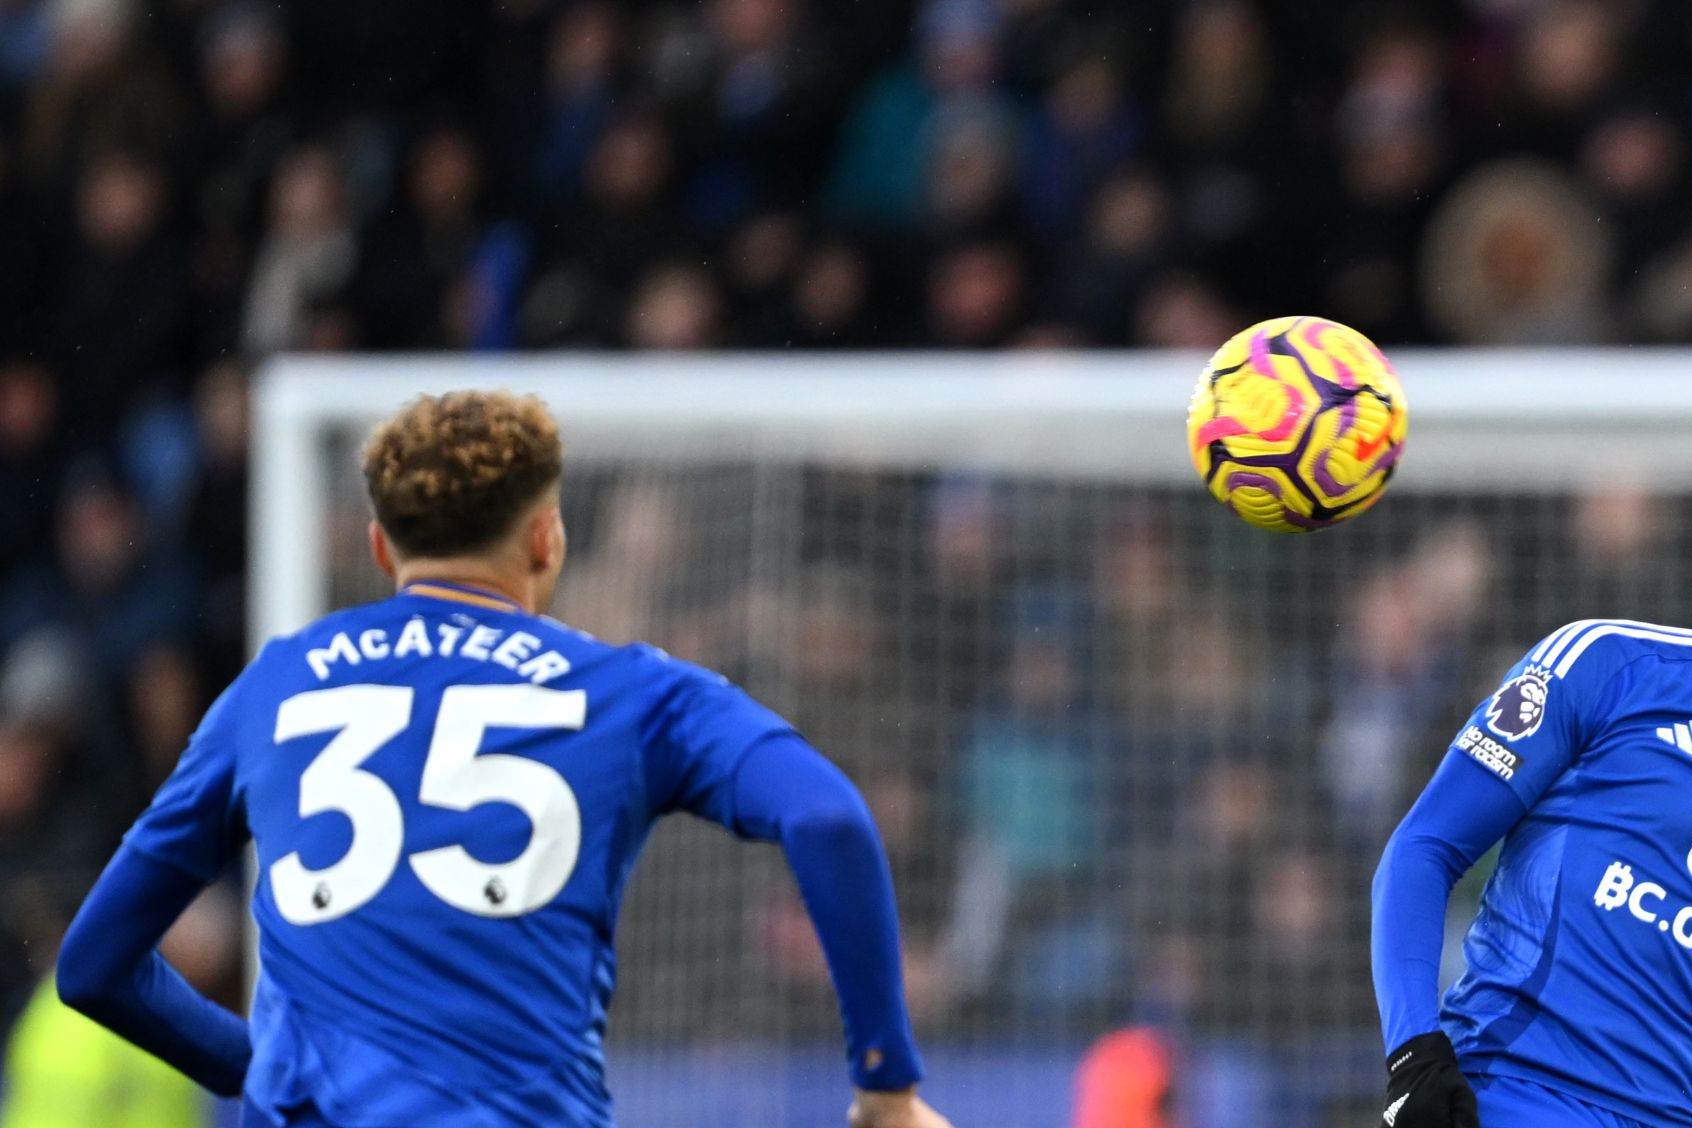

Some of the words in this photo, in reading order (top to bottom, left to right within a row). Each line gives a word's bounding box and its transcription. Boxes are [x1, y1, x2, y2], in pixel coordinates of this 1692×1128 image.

[1470, 744, 1514, 781] racism
[1479, 736, 1517, 767] room
[268, 682, 588, 928] 35
